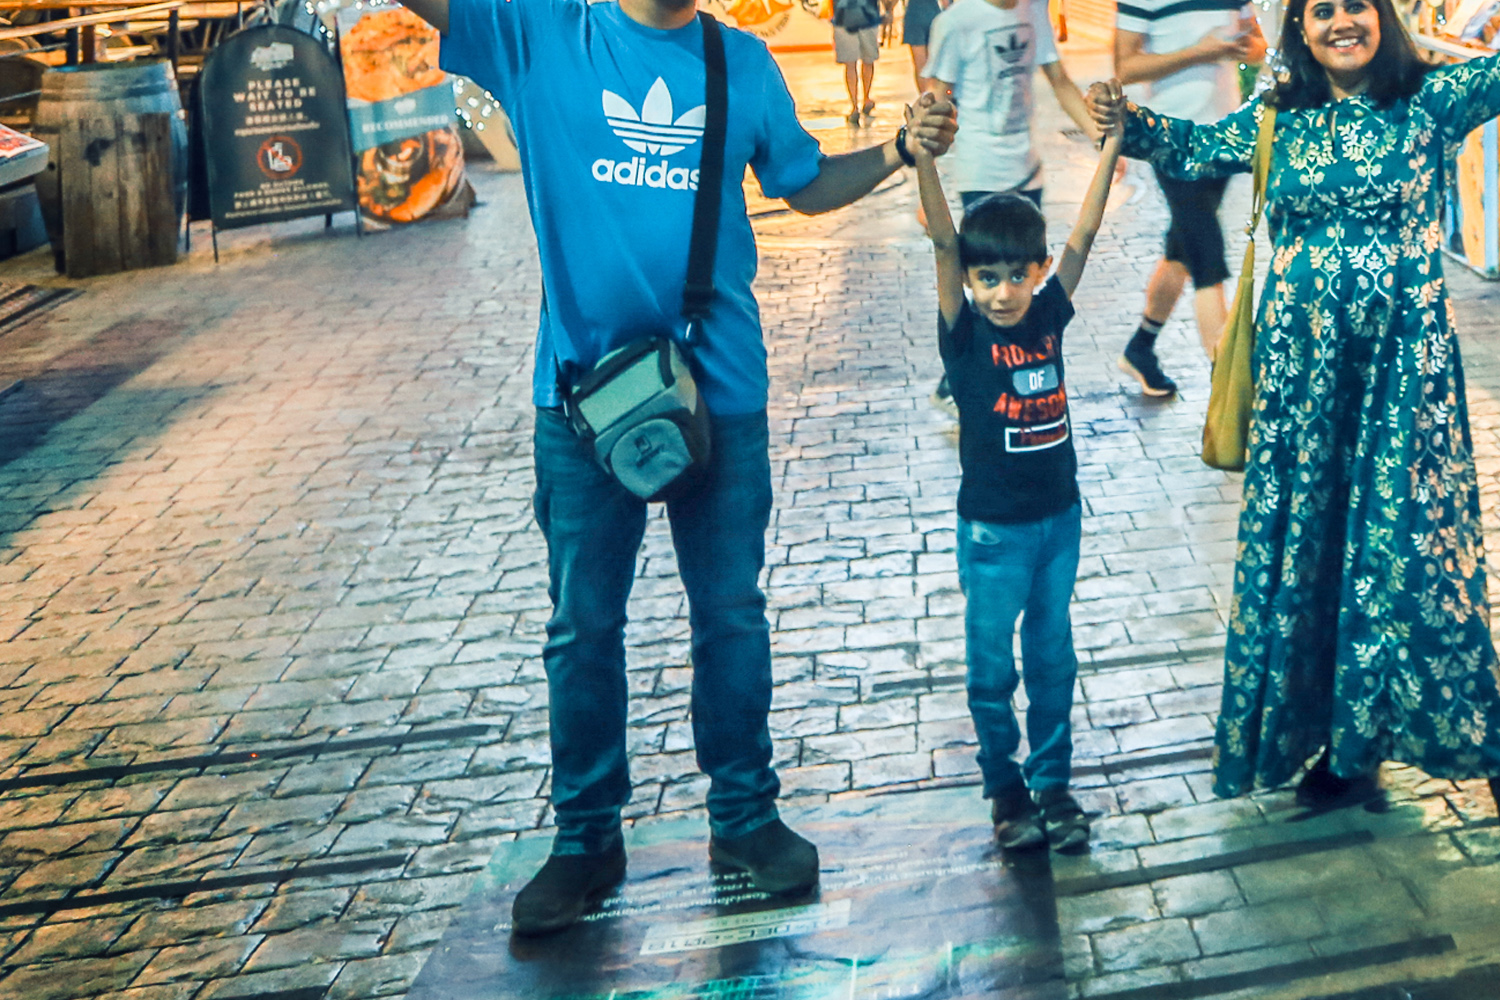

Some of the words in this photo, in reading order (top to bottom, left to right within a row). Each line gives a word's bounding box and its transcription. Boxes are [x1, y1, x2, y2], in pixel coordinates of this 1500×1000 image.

[247, 77, 300, 91] PLEASE
[232, 89, 271, 103] WAIT
[275, 88, 294, 99] TO
[299, 85, 317, 98] BE
[249, 97, 303, 113] SEATED
[361, 114, 450, 134] RECOMMENDED
[591, 155, 700, 191] adidas
[1028, 369, 1046, 391] OF
